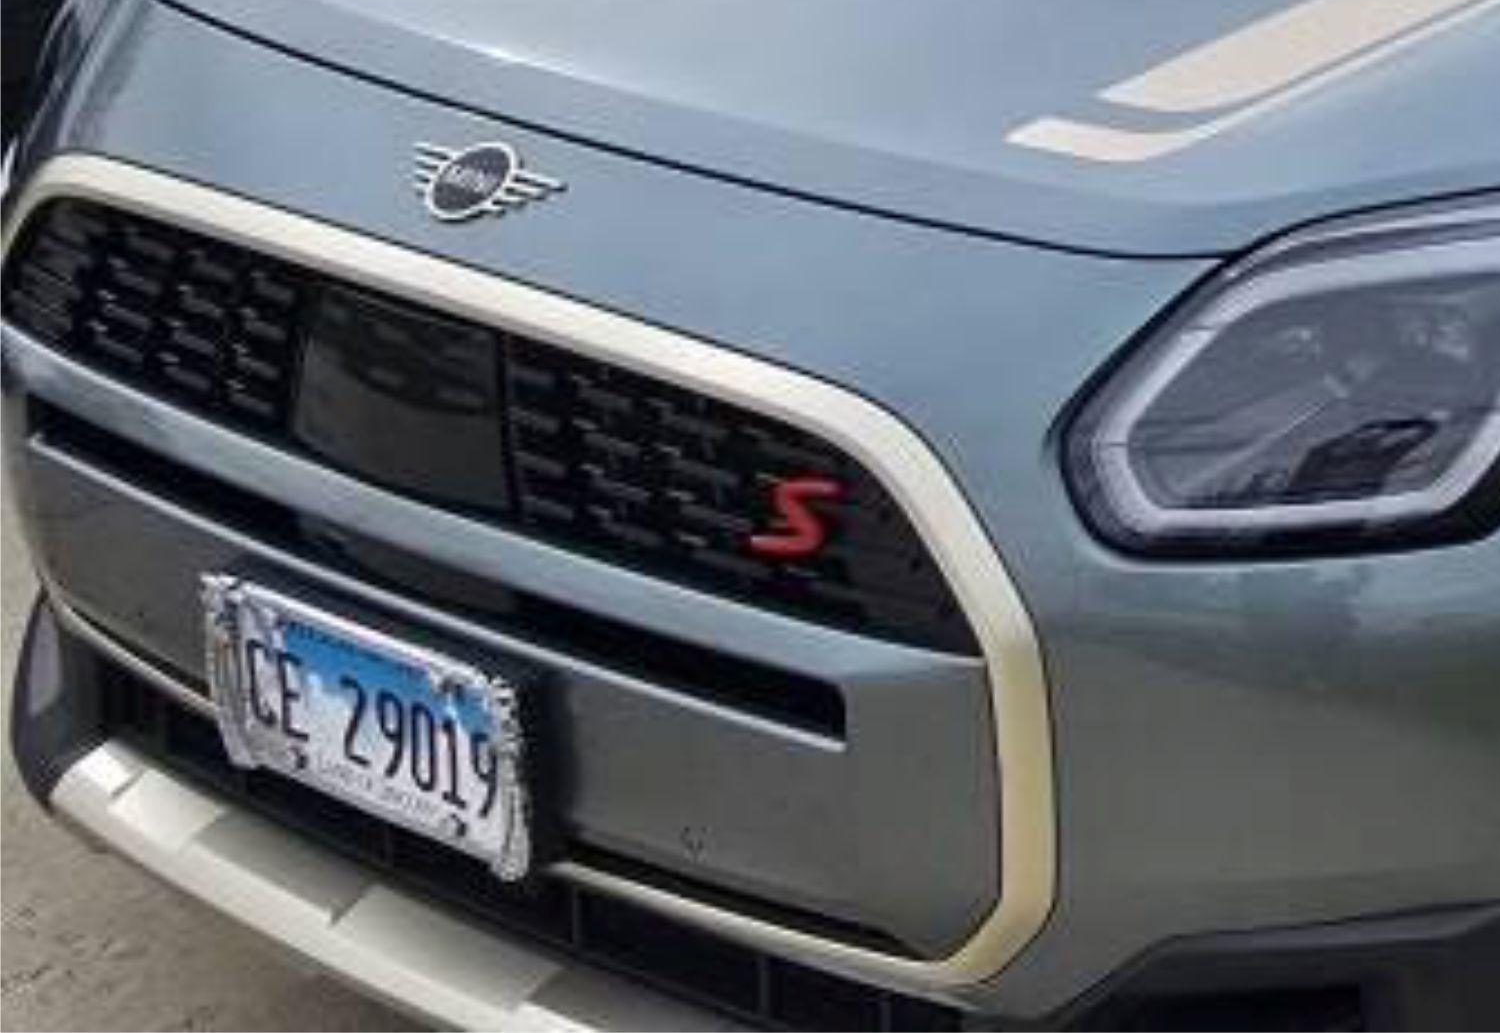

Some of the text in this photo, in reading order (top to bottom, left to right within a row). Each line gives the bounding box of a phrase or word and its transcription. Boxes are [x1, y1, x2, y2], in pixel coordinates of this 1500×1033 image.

[750, 479, 840, 552] S
[246, 639, 309, 742] CE
[339, 674, 497, 819] 29019
